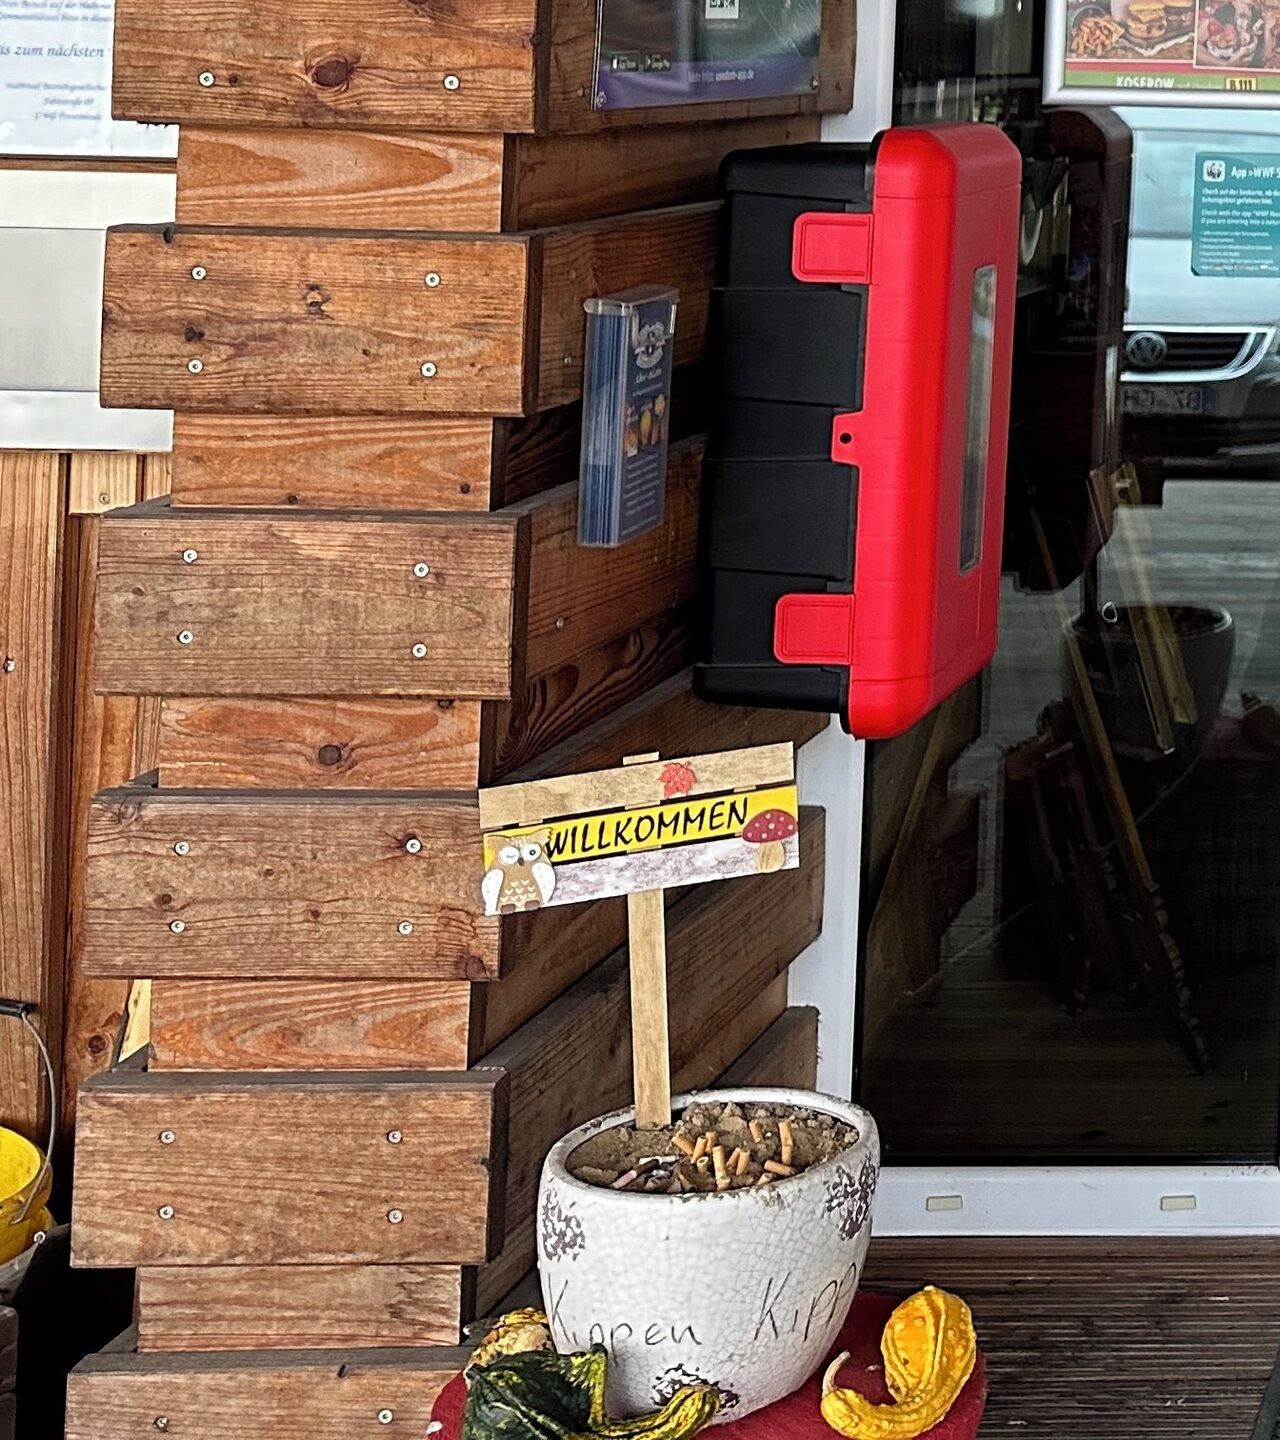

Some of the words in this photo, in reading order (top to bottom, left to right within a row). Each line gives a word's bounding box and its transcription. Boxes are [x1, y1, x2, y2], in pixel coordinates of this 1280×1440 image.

[15, 46, 42, 56] zum
[47, 43, 104, 57] nächsten
[1231, 166, 1247, 179] App
[548, 797, 748, 858] WILLKOMMEN
